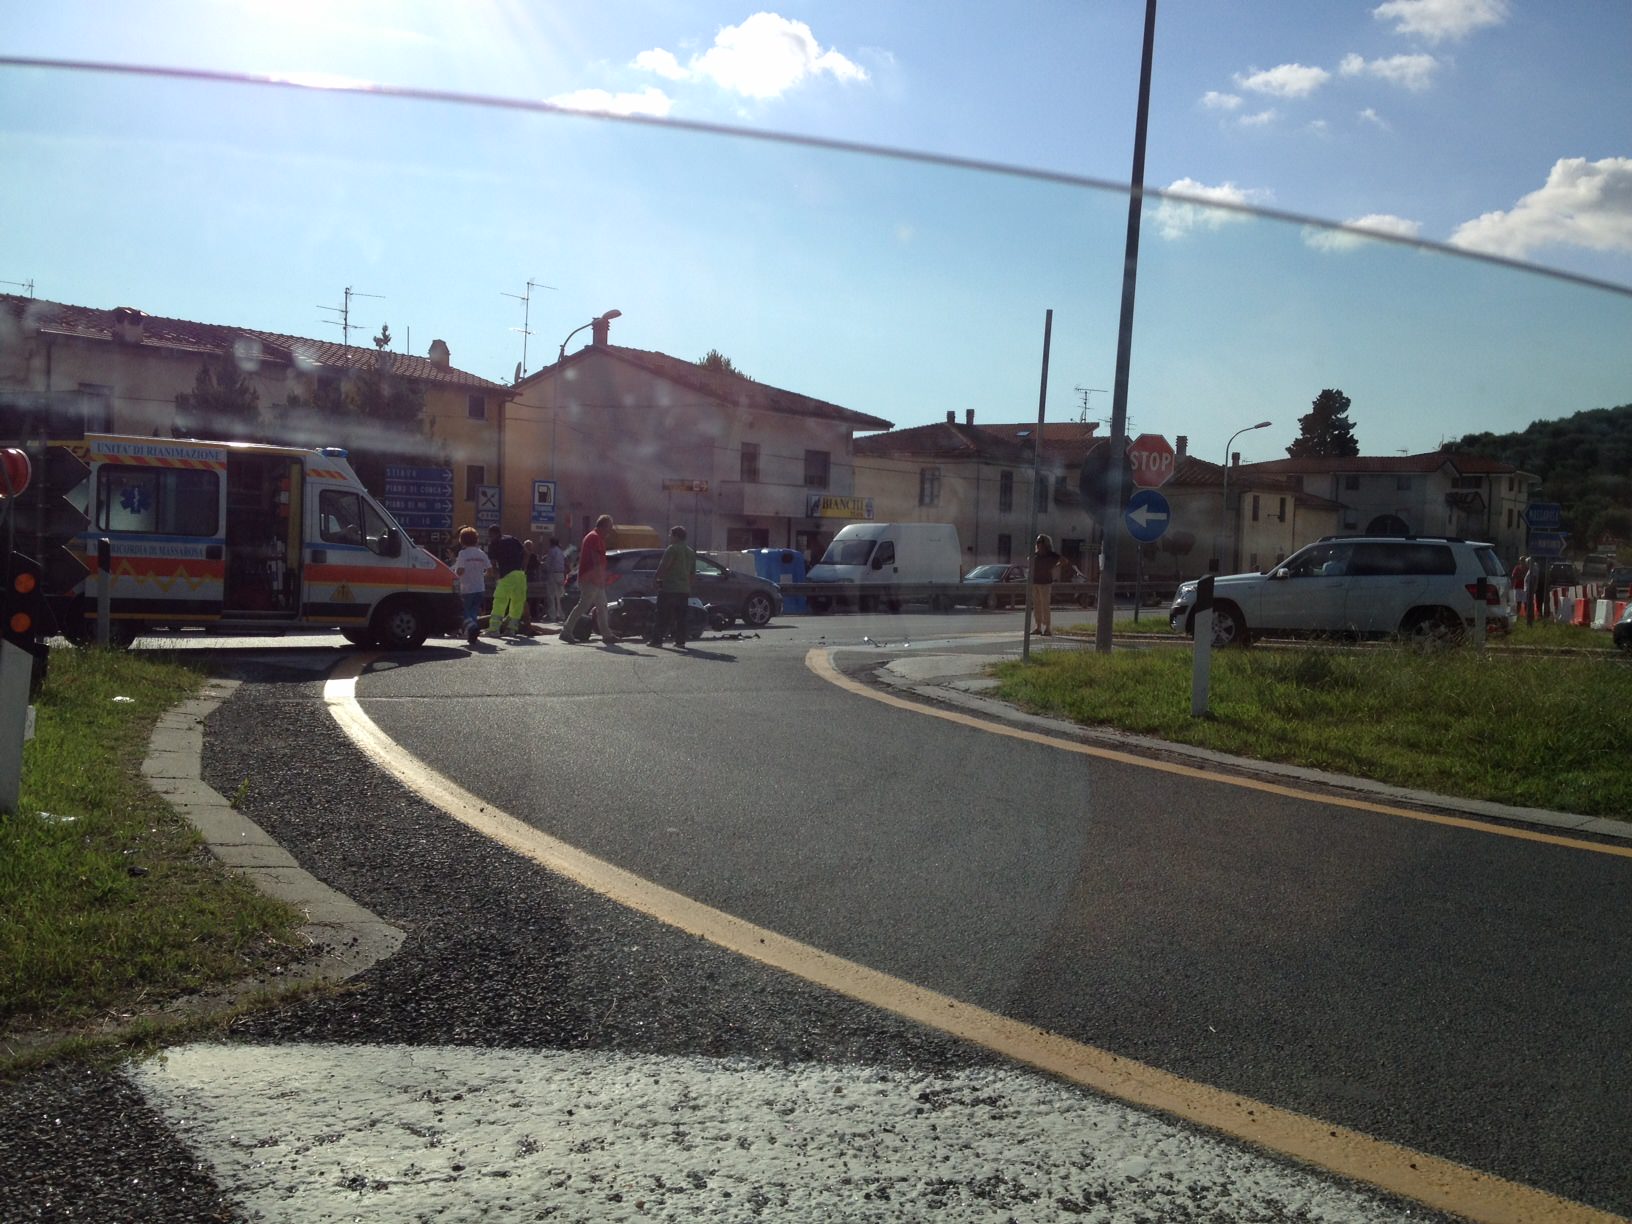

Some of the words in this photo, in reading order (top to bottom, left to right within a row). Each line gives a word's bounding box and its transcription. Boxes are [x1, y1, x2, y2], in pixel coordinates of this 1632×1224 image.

[133, 445, 145, 456] DI
[146, 446, 220, 461] RIANIMAZIONE
[1130, 450, 1172, 471] STOP
[822, 497, 863, 511] BIANCHI
